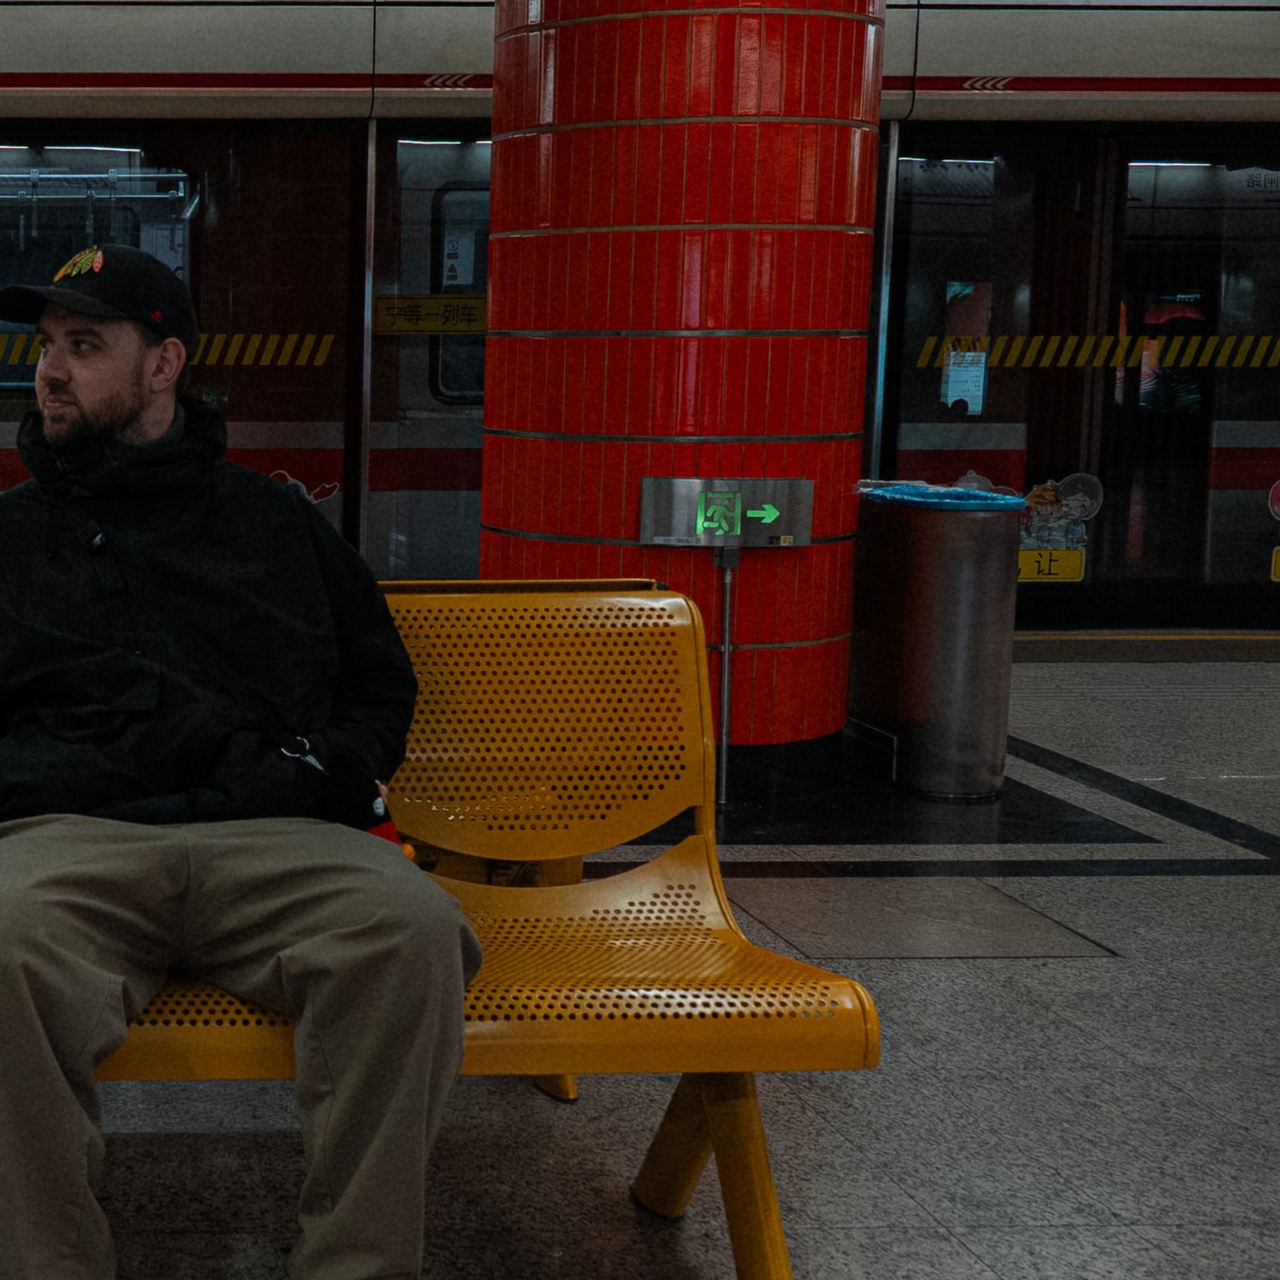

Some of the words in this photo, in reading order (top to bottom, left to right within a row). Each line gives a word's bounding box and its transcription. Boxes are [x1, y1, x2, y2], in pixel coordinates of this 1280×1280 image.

[386, 303, 479, 326] 宁等一列车
